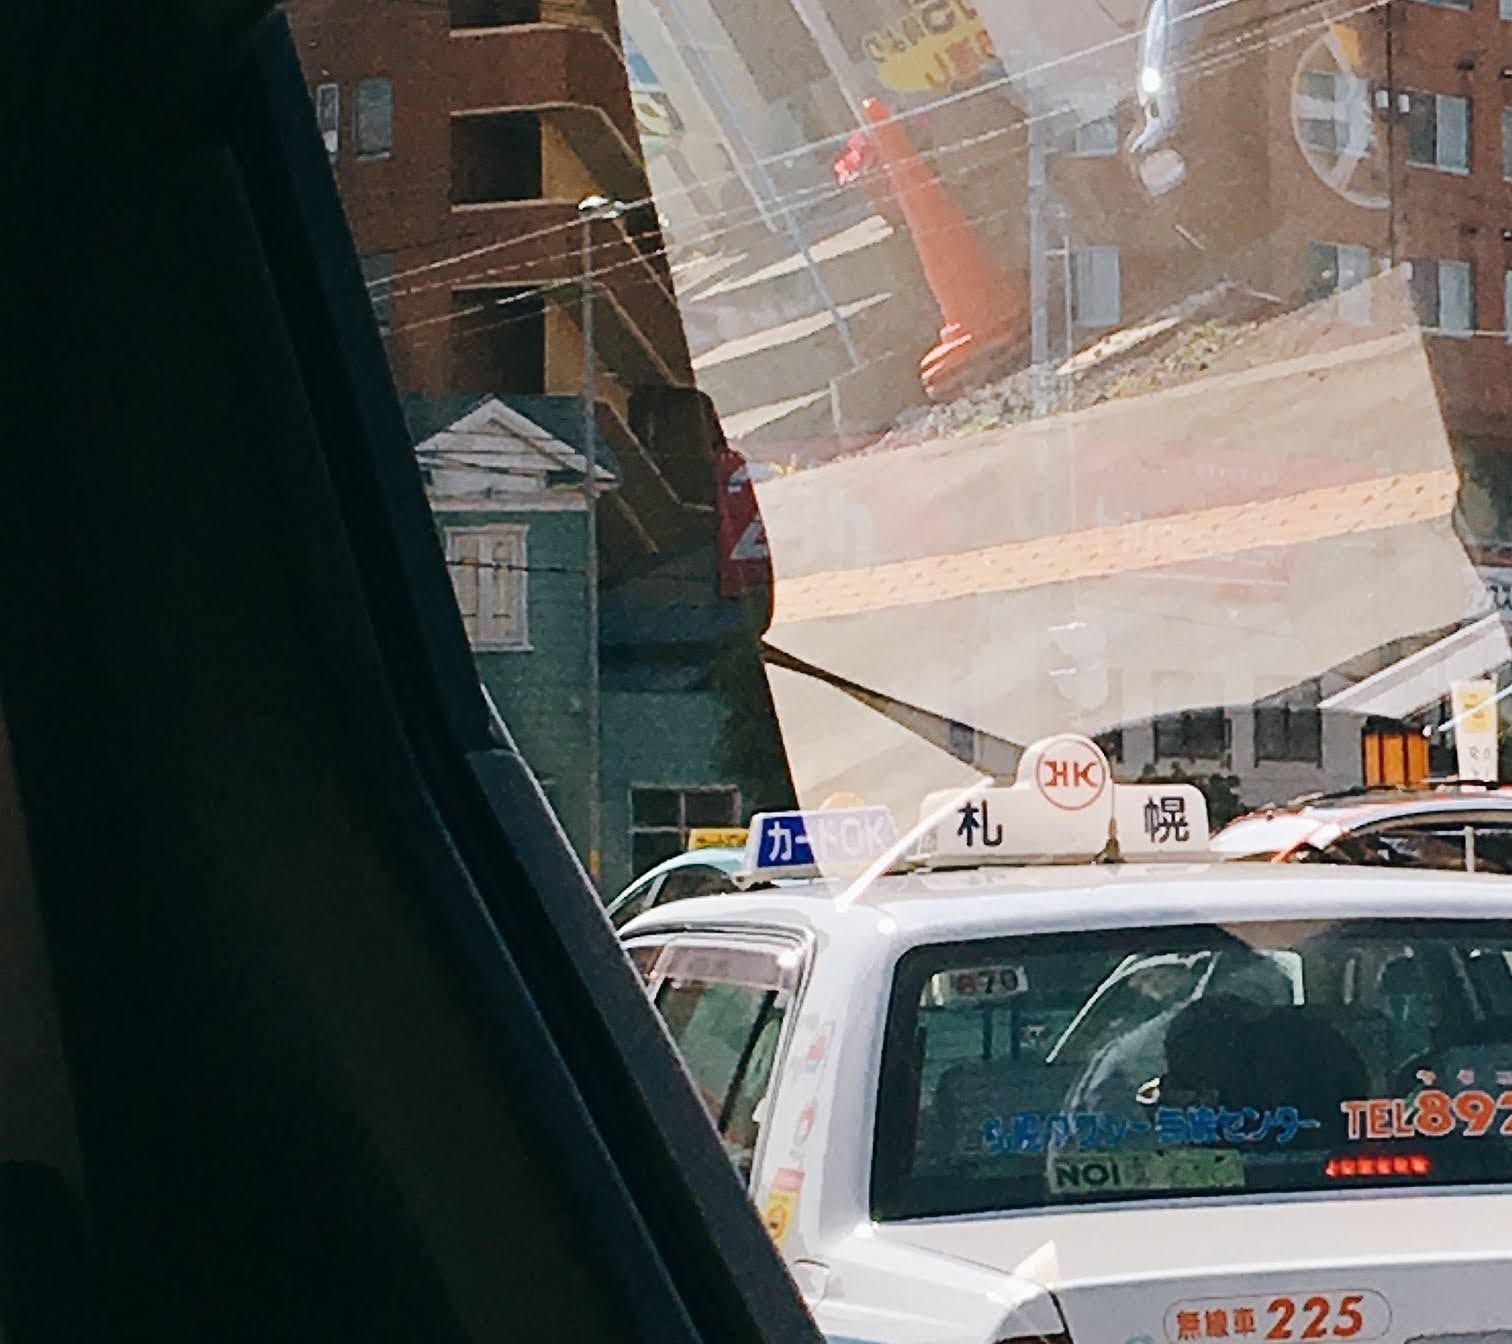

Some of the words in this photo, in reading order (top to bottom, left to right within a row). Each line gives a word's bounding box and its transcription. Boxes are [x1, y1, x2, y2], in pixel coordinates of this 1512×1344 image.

[1044, 761, 1098, 787] HK
[957, 800, 1011, 847] 札
[1144, 796, 1190, 843] 幌
[1264, 1295, 1365, 1340] 225
